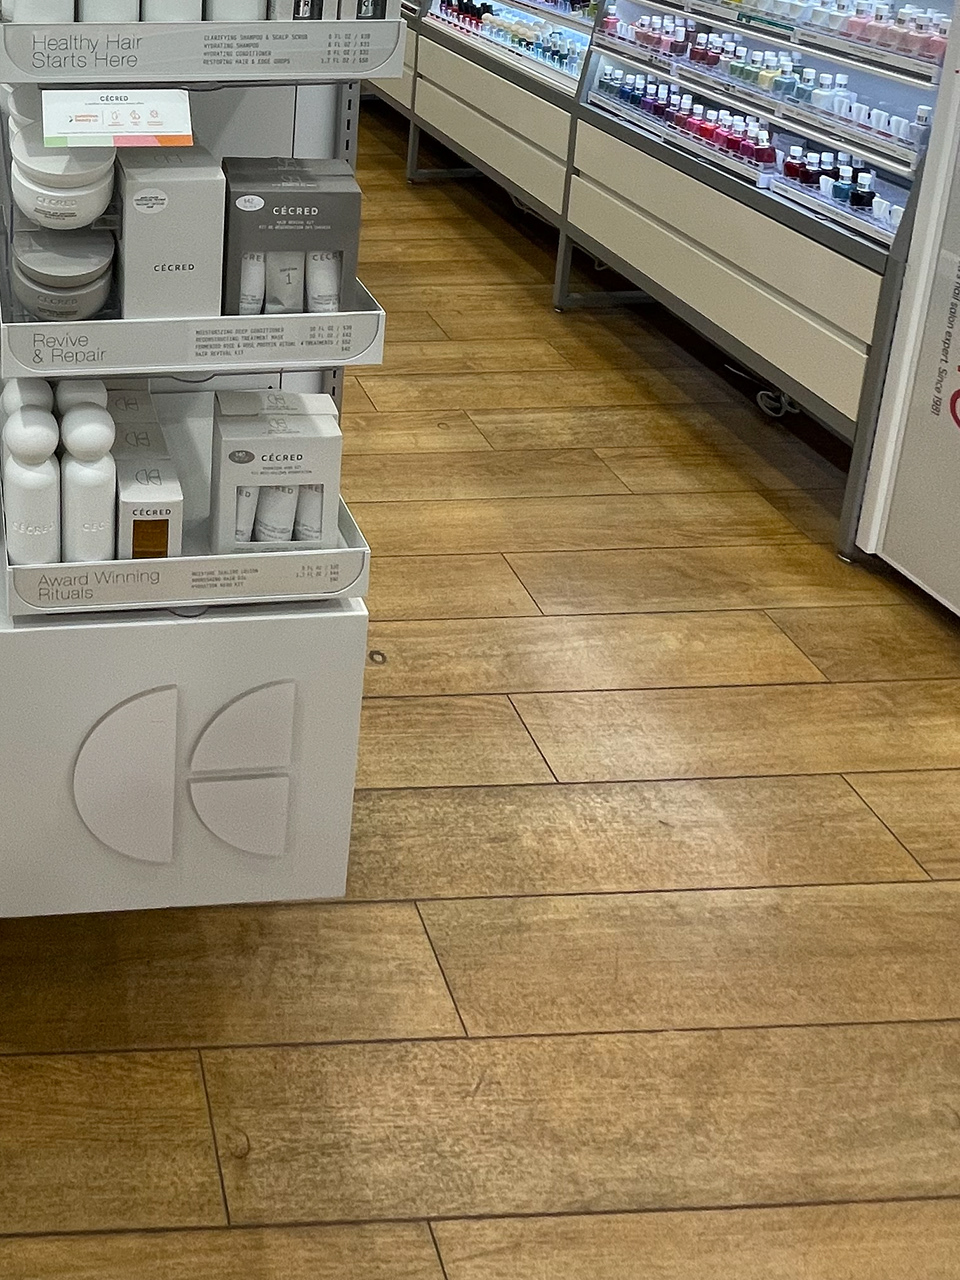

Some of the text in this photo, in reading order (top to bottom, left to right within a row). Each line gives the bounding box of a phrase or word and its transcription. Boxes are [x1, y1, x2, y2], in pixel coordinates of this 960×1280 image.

[32, 33, 142, 54] Healthy Hair
[32, 51, 139, 68] Starts Here
[272, 205, 319, 216] CÉCRED
[154, 262, 195, 272] CÉCRED
[947, 300, 958, 330] salon
[32, 332, 89, 349] Revive
[32, 348, 107, 364] & Repair
[934, 366, 948, 393] Since
[930, 393, 943, 416] 1981
[261, 452, 303, 461] CÉCRED
[132, 508, 172, 516] CÉCRED
[38, 570, 160, 587] Award Winning
[38, 586, 94, 601] Rituals
